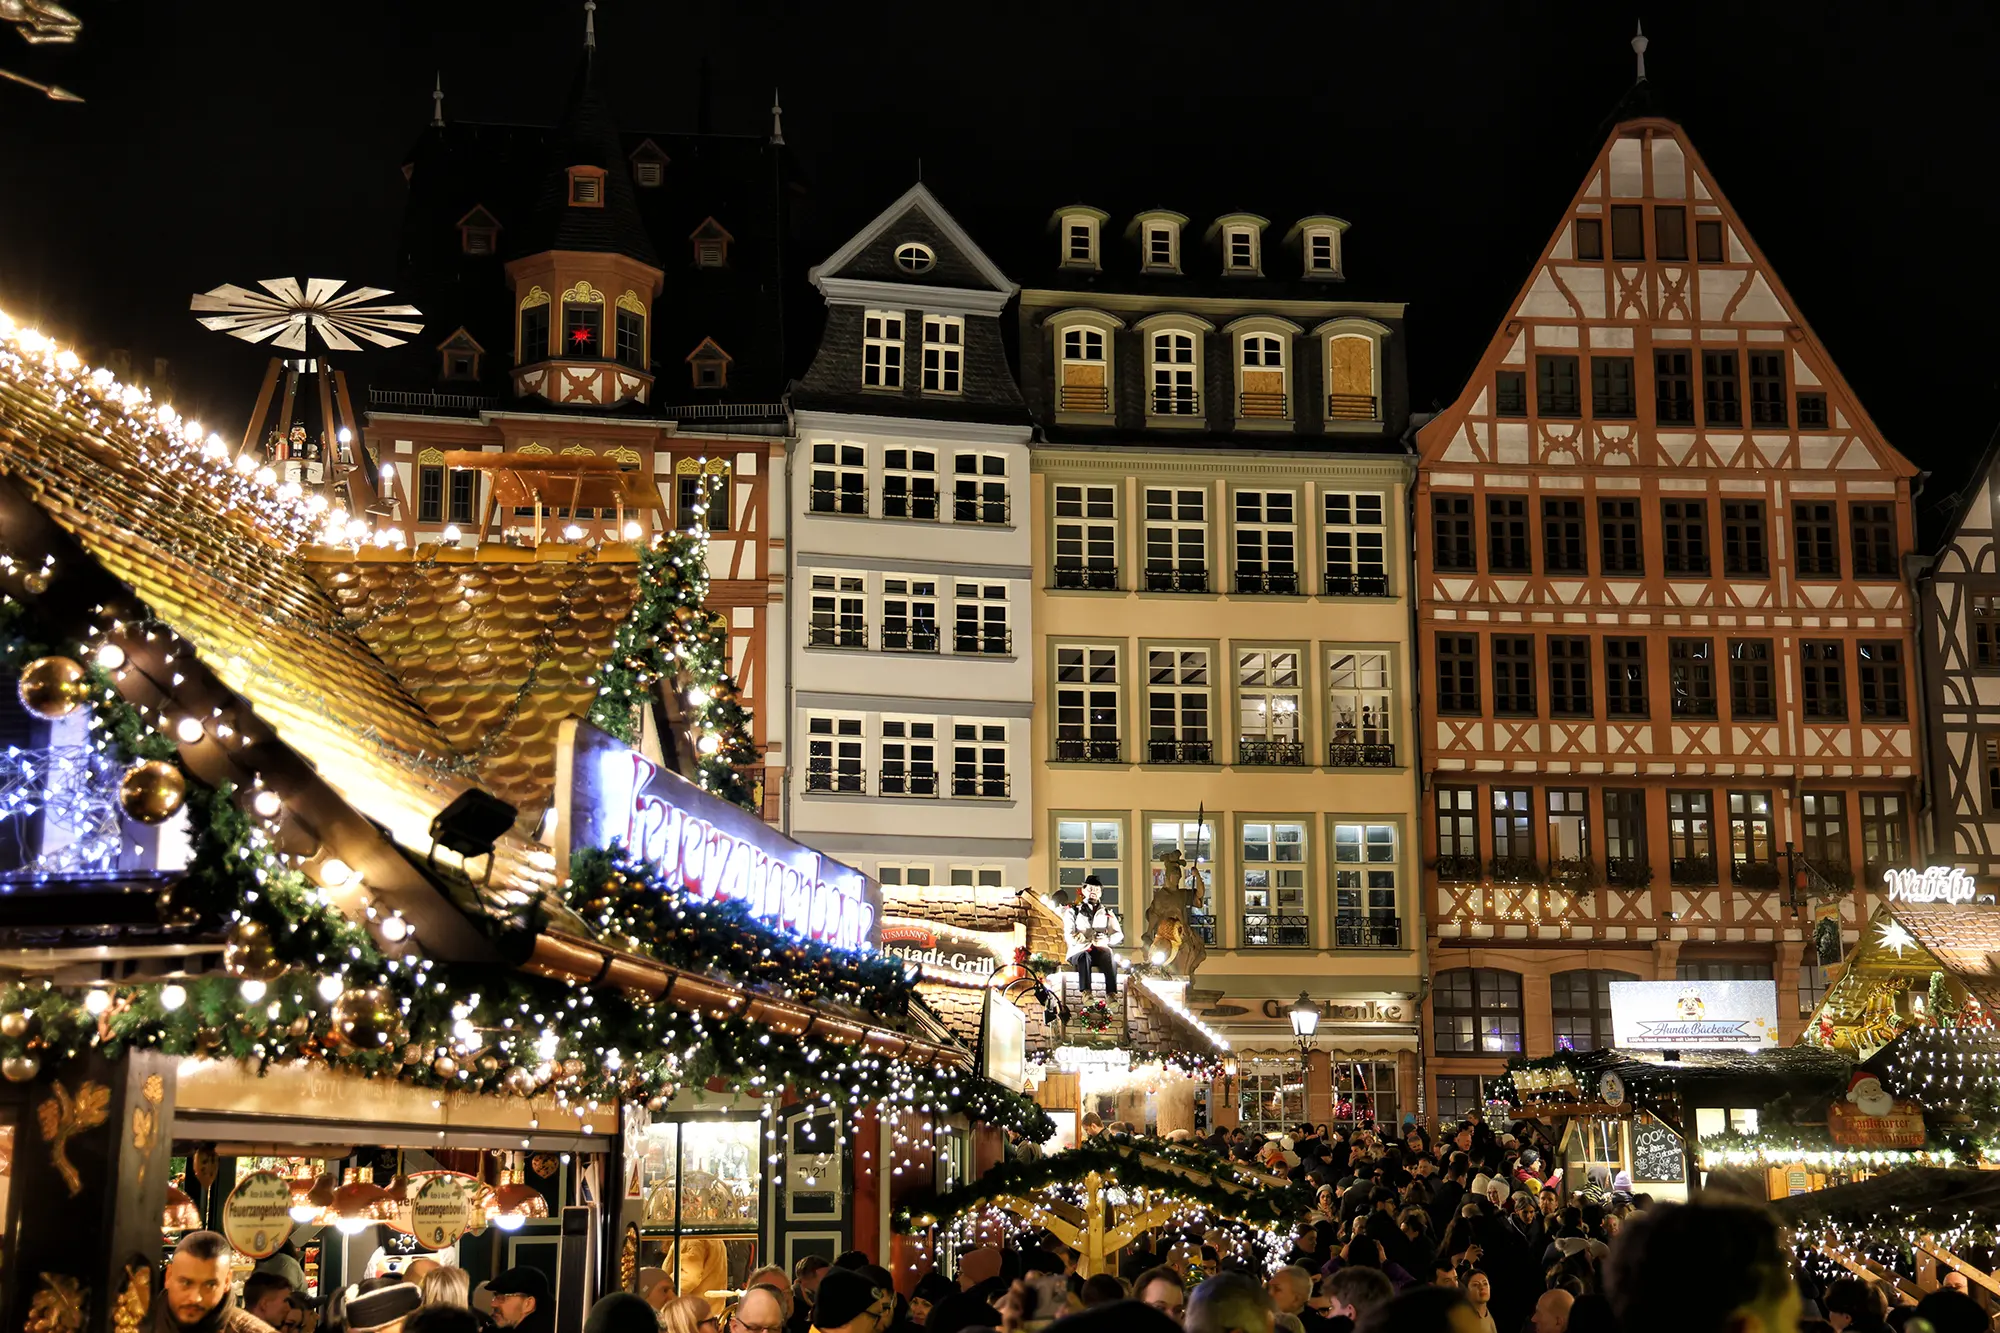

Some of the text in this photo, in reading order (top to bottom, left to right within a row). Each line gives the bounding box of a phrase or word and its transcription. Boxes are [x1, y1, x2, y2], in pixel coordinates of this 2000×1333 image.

[1884, 866, 1975, 905] Waffeln
[1263, 1000, 1402, 1020] Gehenke
[1653, 1023, 1689, 1035] Hunde
